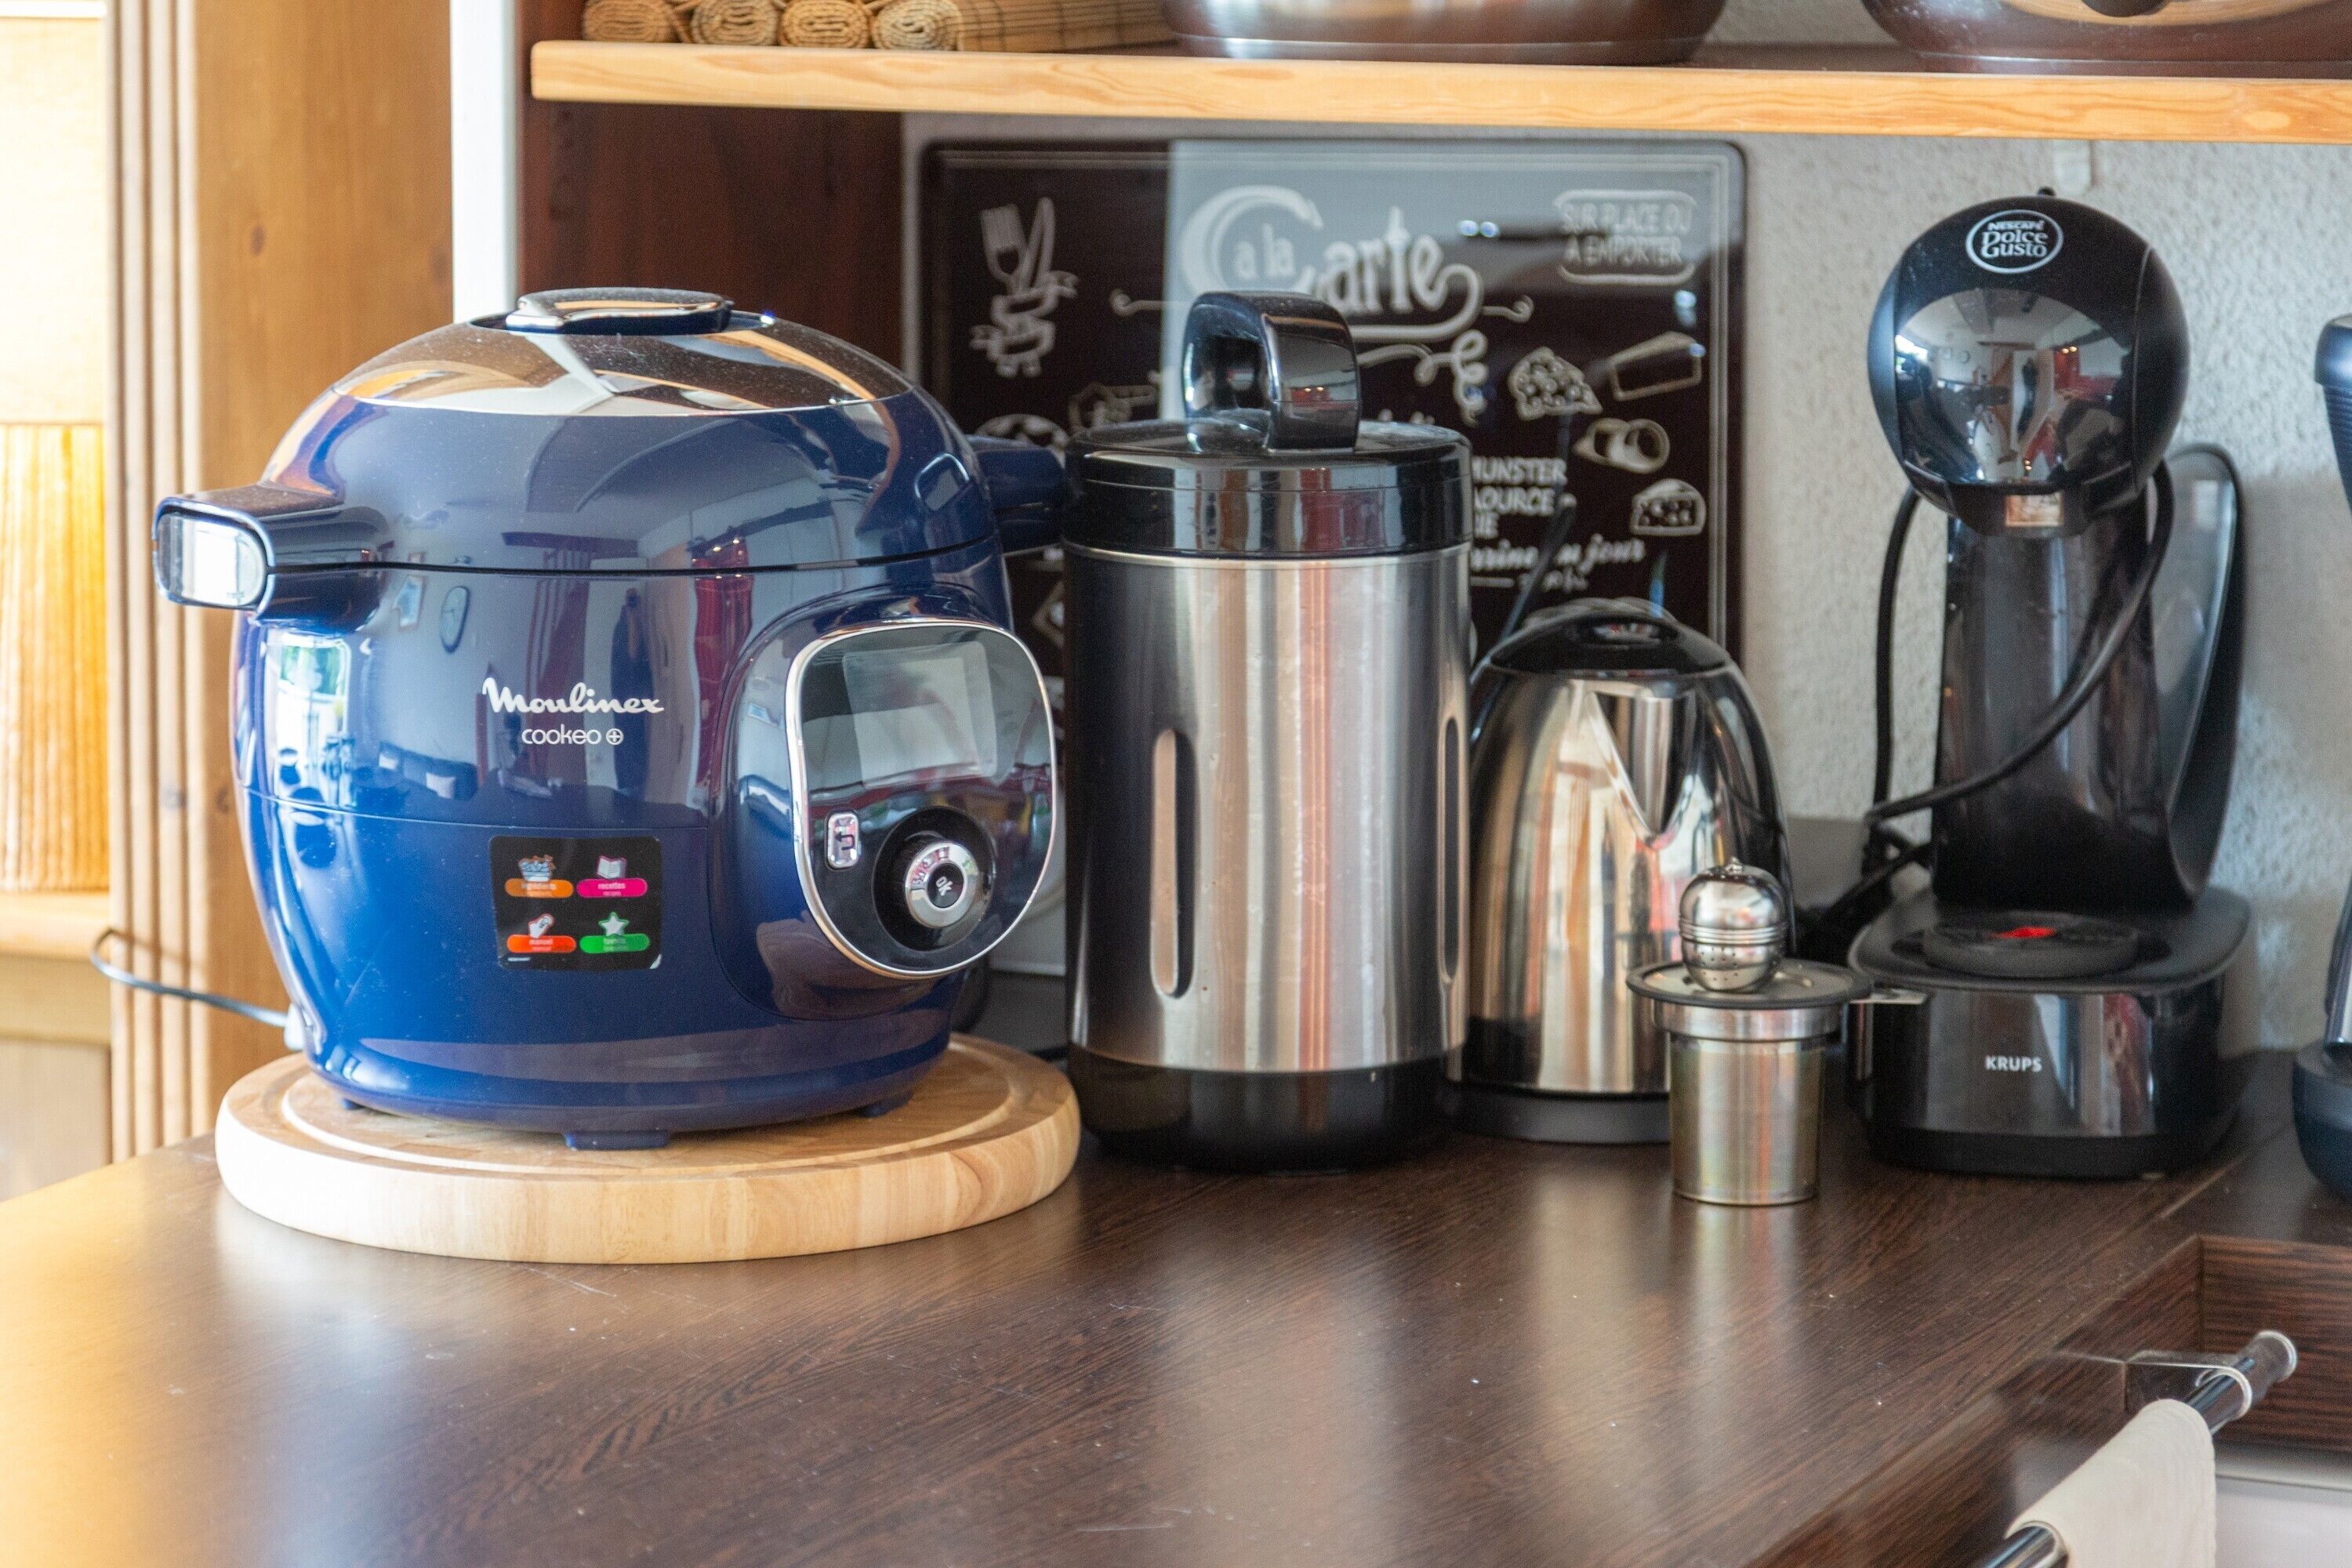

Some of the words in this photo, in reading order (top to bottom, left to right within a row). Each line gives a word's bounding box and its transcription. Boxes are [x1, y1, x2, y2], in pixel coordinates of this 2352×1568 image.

[1982, 229, 2049, 245] Dolce
[1181, 184, 1465, 315] Carte
[1981, 242, 2047, 259] Gusto
[482, 677, 665, 713] Moulinex
[521, 724, 601, 745] cookeo
[1985, 1055, 2042, 1073] KRUPS
